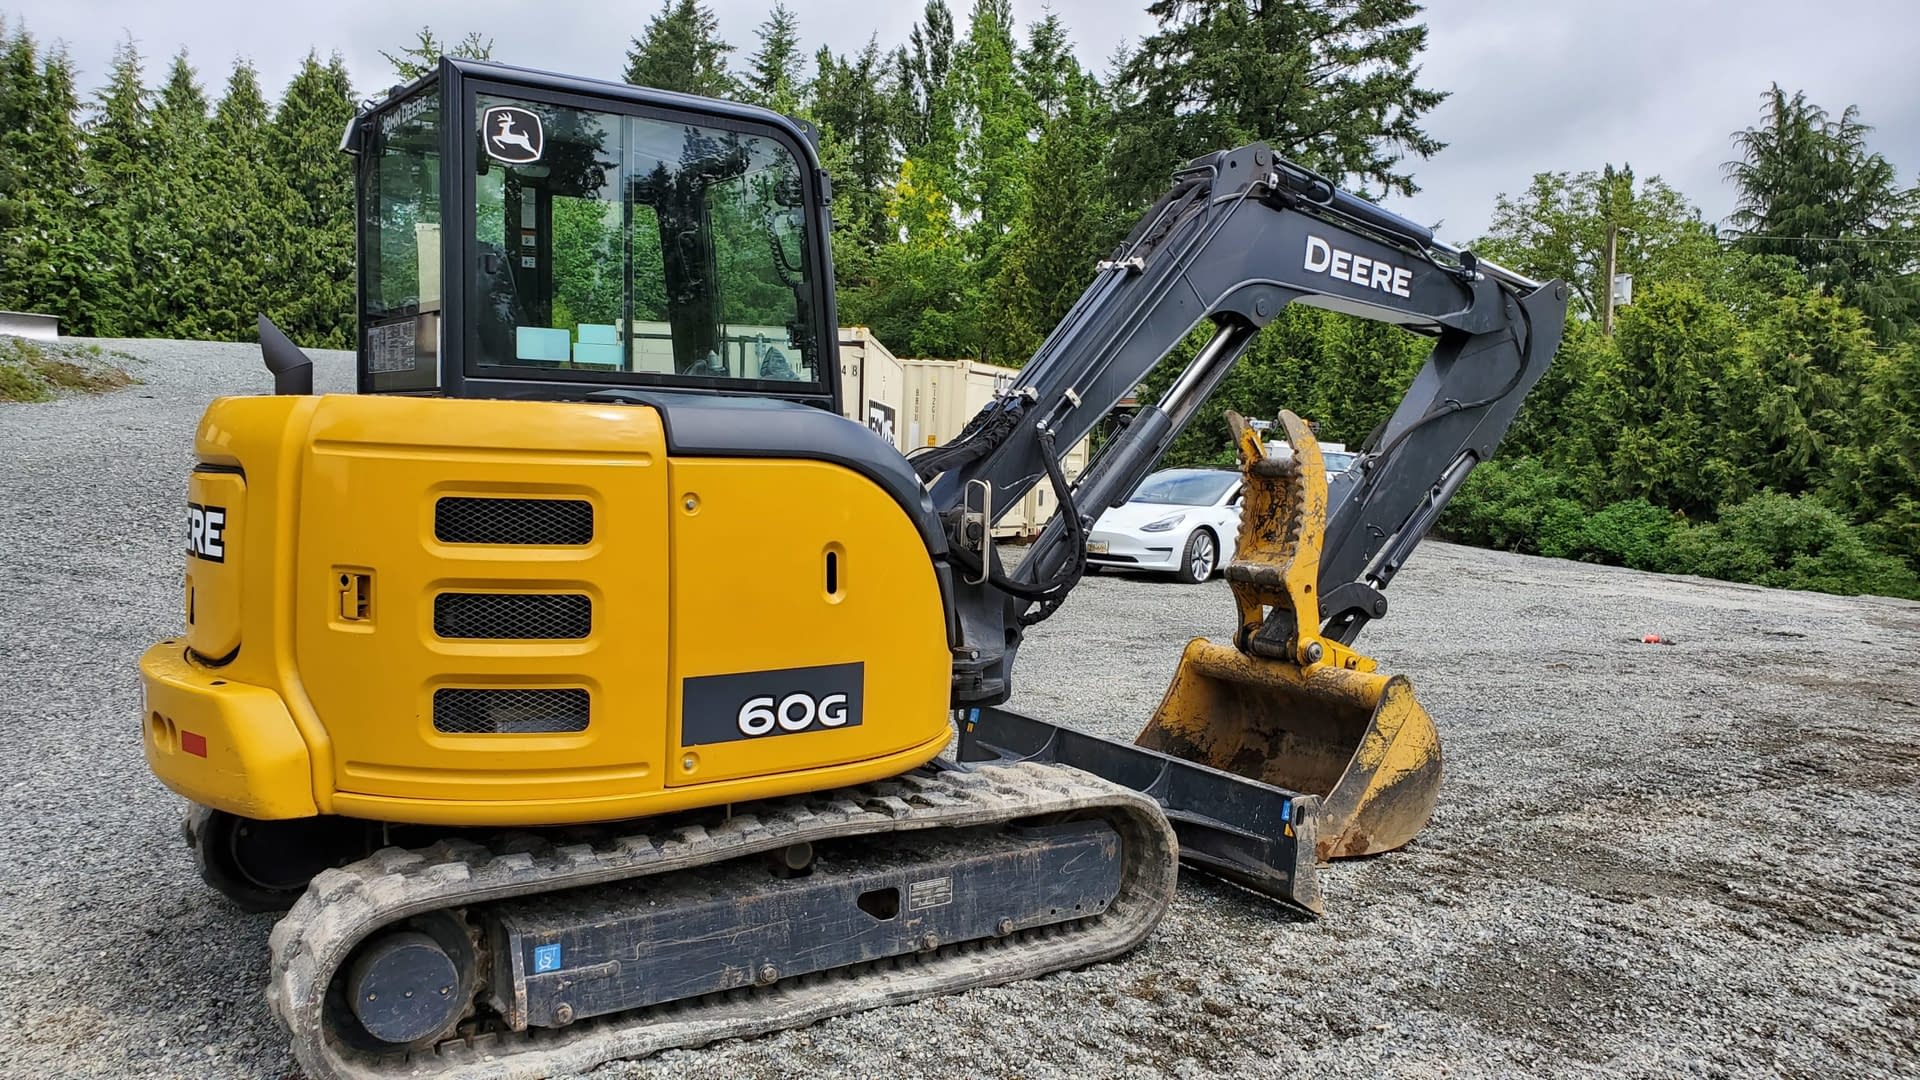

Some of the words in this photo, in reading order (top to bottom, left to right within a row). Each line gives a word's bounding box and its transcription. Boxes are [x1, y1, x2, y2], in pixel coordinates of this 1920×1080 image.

[382, 109, 401, 135] JOHN
[401, 95, 427, 123] DEERE
[1304, 235, 1412, 298] DEERE
[738, 693, 847, 736] 60G
